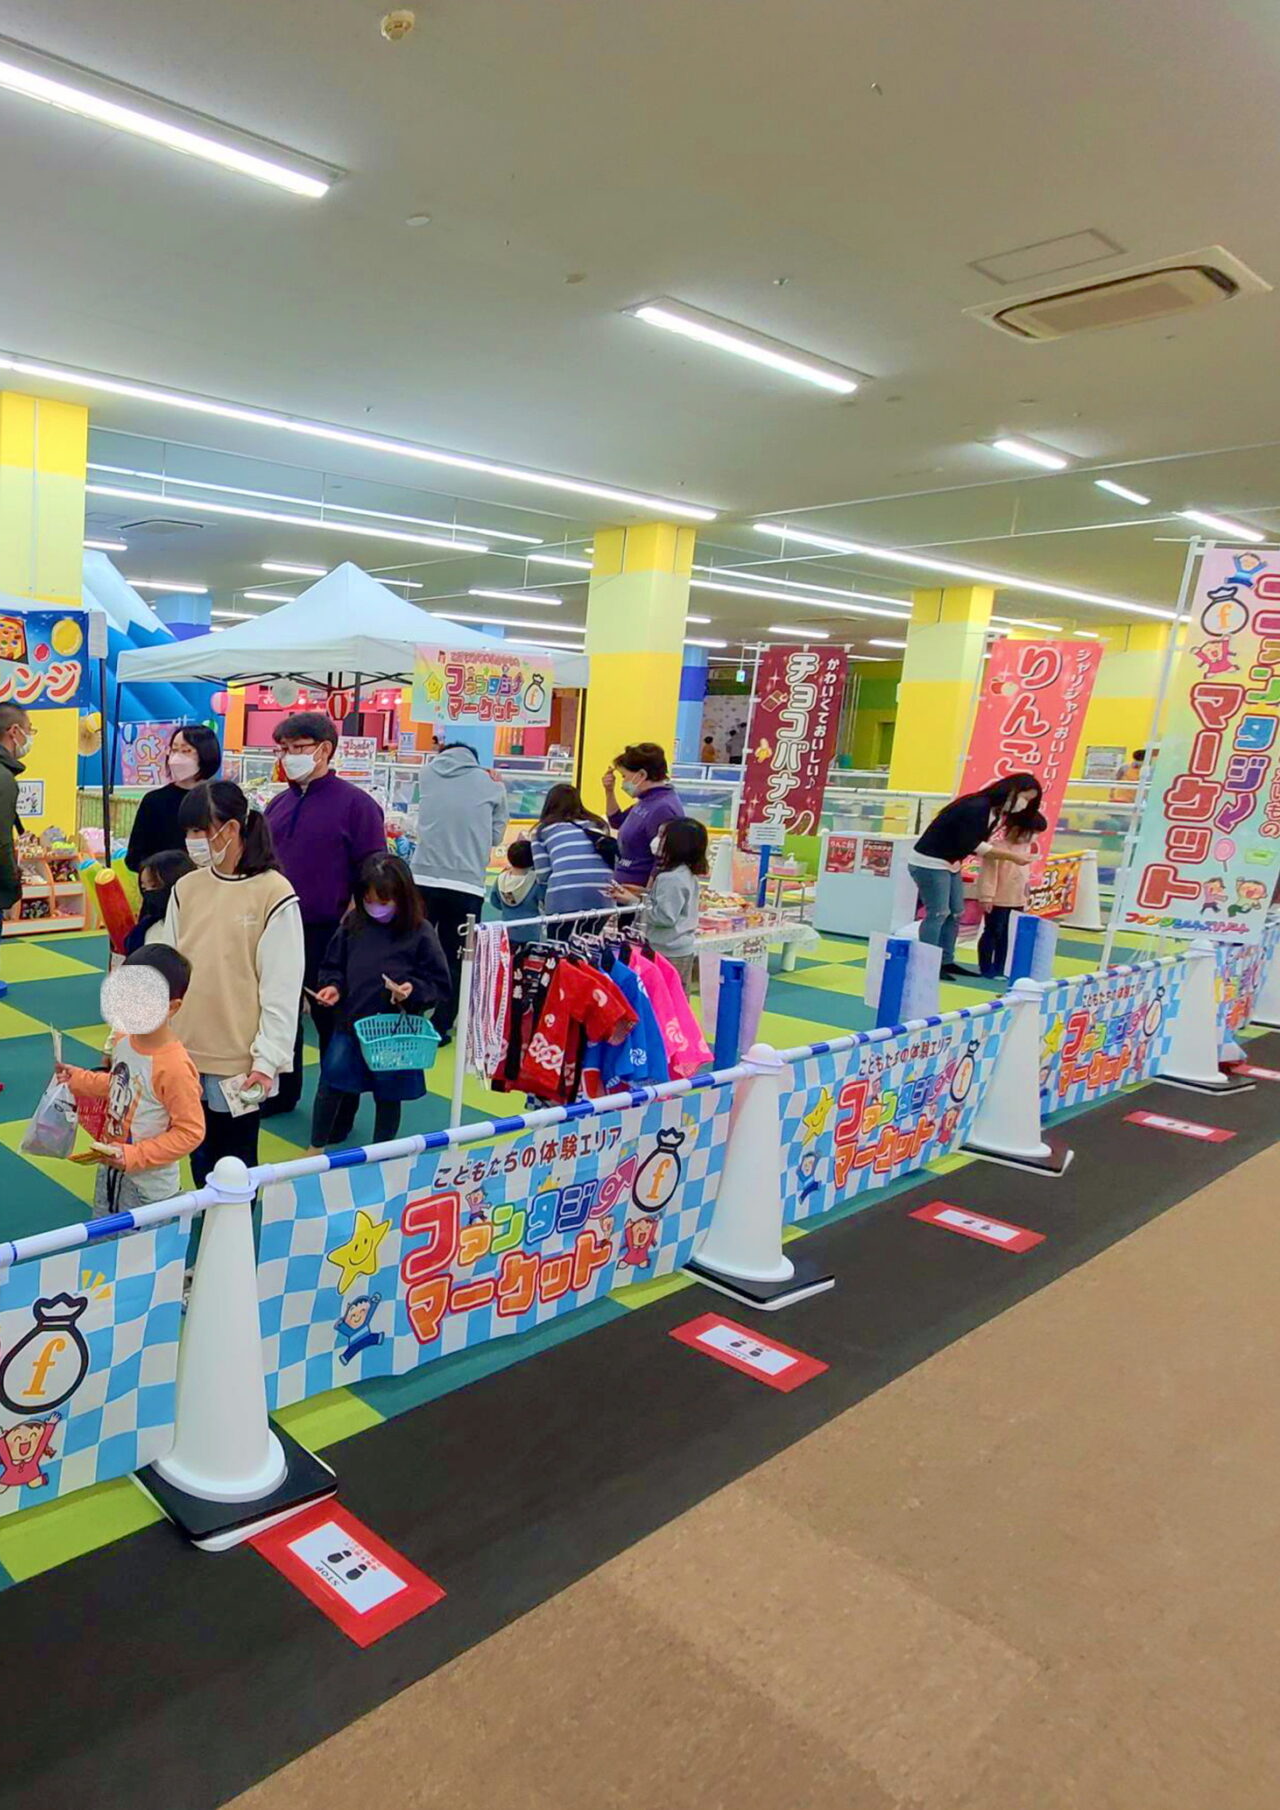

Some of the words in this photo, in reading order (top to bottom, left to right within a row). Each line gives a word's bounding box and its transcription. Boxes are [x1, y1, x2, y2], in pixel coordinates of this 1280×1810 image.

[447, 696, 520, 722] マーケット
[762, 652, 820, 824] チョコバナナ
[1136, 682, 1245, 910] マーケット
[433, 1126, 622, 1189] こどもたちの体験エリア
[834, 1113, 936, 1190] マーケット
[404, 1230, 613, 1345] マーケット
